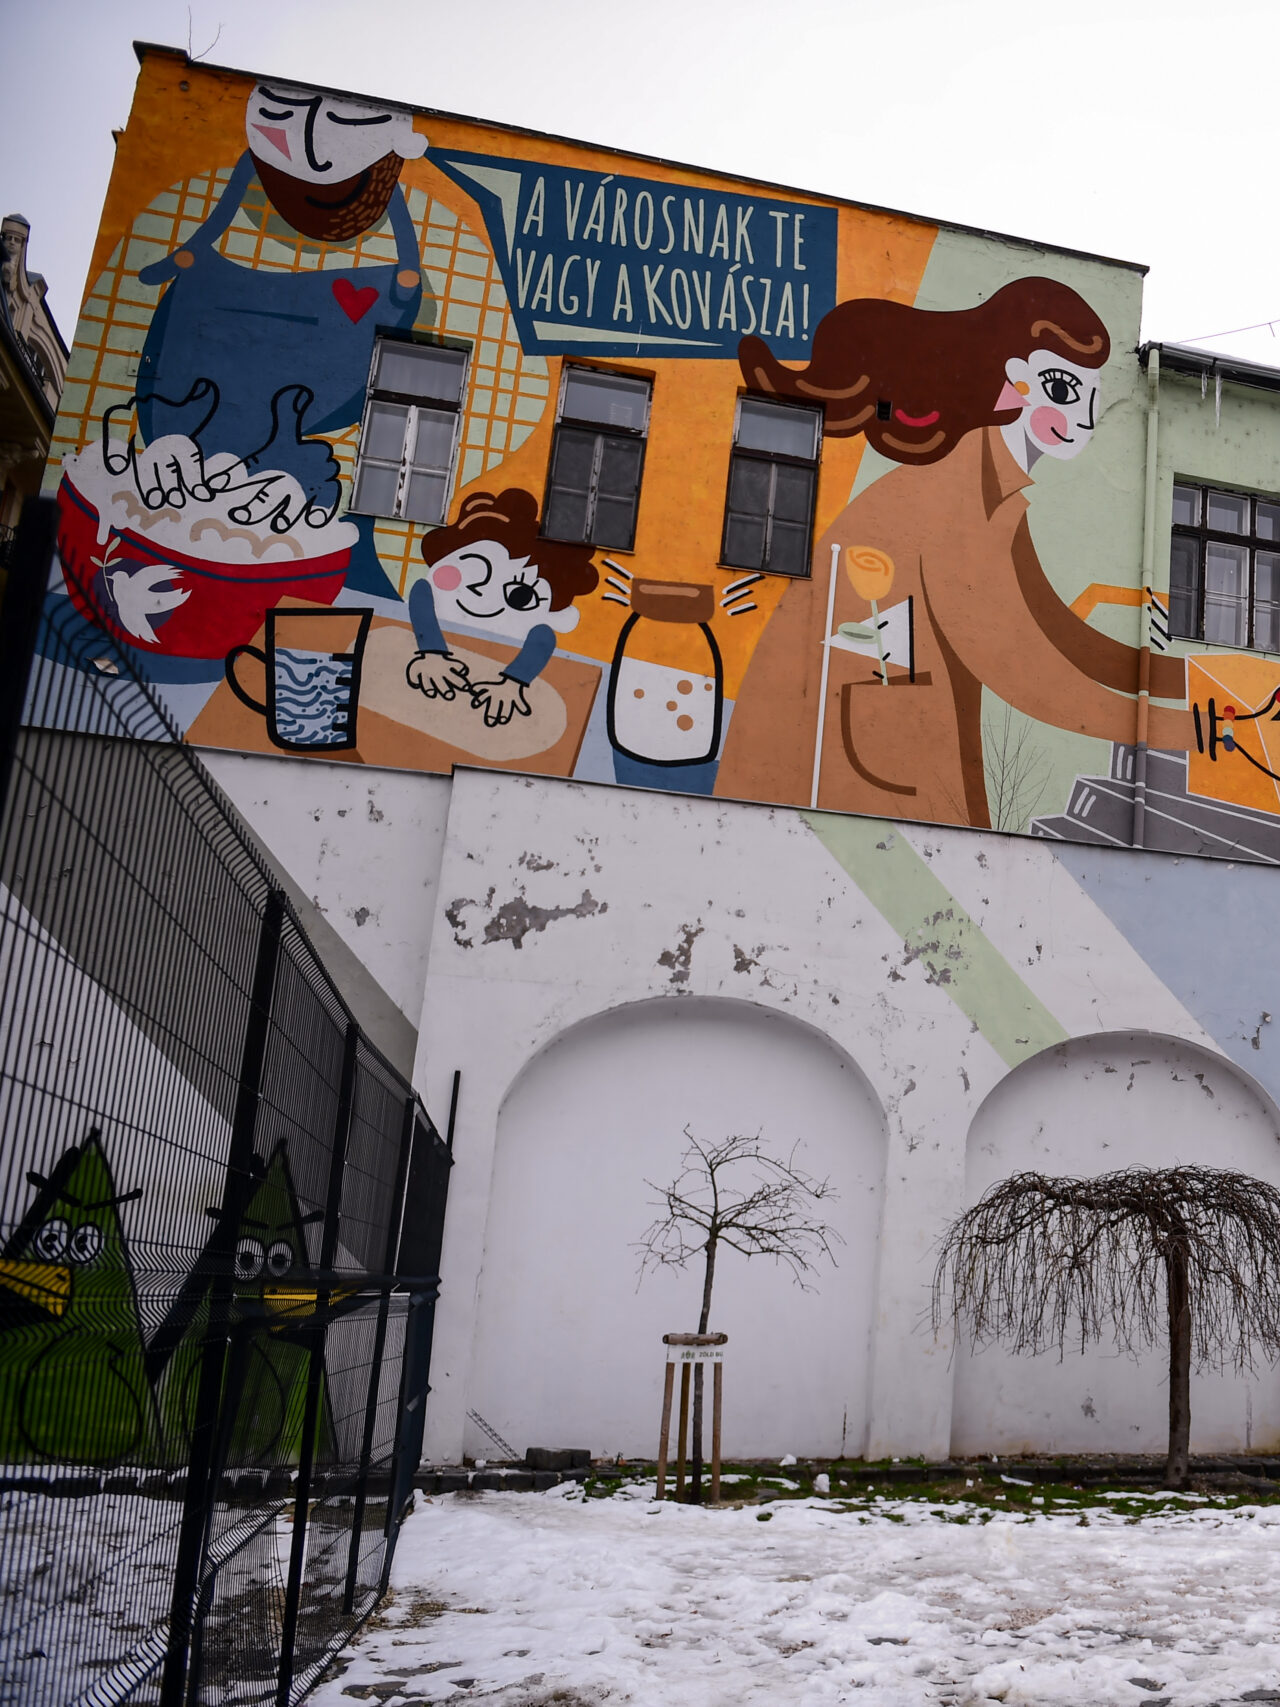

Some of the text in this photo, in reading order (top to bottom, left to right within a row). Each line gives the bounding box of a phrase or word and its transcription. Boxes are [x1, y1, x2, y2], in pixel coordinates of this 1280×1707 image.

[522, 175, 807, 271] A VÁROSNAK TE
[516, 248, 810, 341] VAGY A KOVÁSZA!
